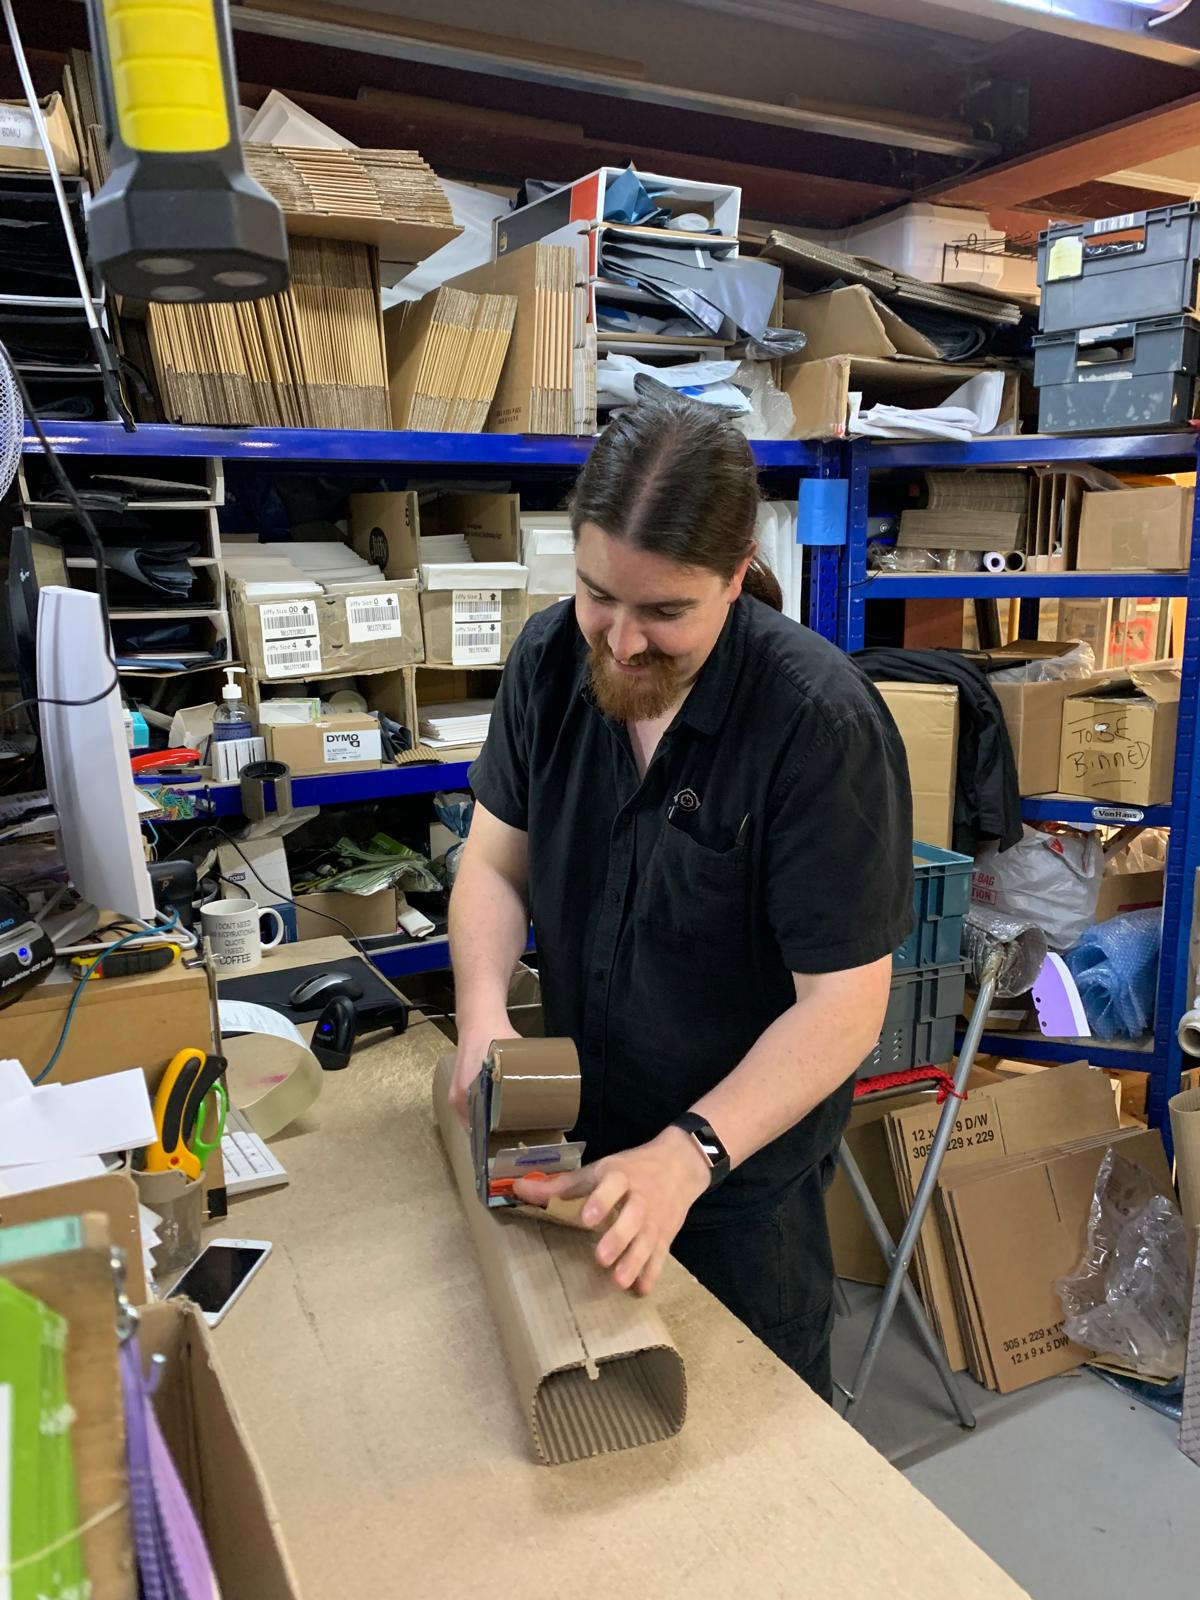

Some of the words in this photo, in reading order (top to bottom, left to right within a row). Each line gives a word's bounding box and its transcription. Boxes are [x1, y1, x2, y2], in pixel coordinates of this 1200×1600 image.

[1096, 717, 1131, 742] BE
[326, 734, 359, 743] DYMO
[1098, 810, 1138, 819] VonHaus
[978, 872, 995, 886] BAG
[219, 953, 252, 965] COFFEE
[911, 1129, 926, 1142] 12
[955, 1120, 962, 1132] 9
[964, 1113, 988, 1130] D/W
[966, 1136, 974, 1146] x
[975, 1130, 995, 1144] 229
[1002, 1338, 1020, 1352] 305
[1022, 1337, 1028, 1345] x
[1028, 1328, 1045, 1342] 229
[1046, 1328, 1052, 1336] x
[1011, 1353, 1023, 1365] 12
[1024, 1352, 1030, 1361] x
[1030, 1347, 1037, 1358] 9
[1039, 1346, 1045, 1355] x
[1046, 1342, 1052, 1352] 5
[1053, 1335, 1070, 1350] DW
